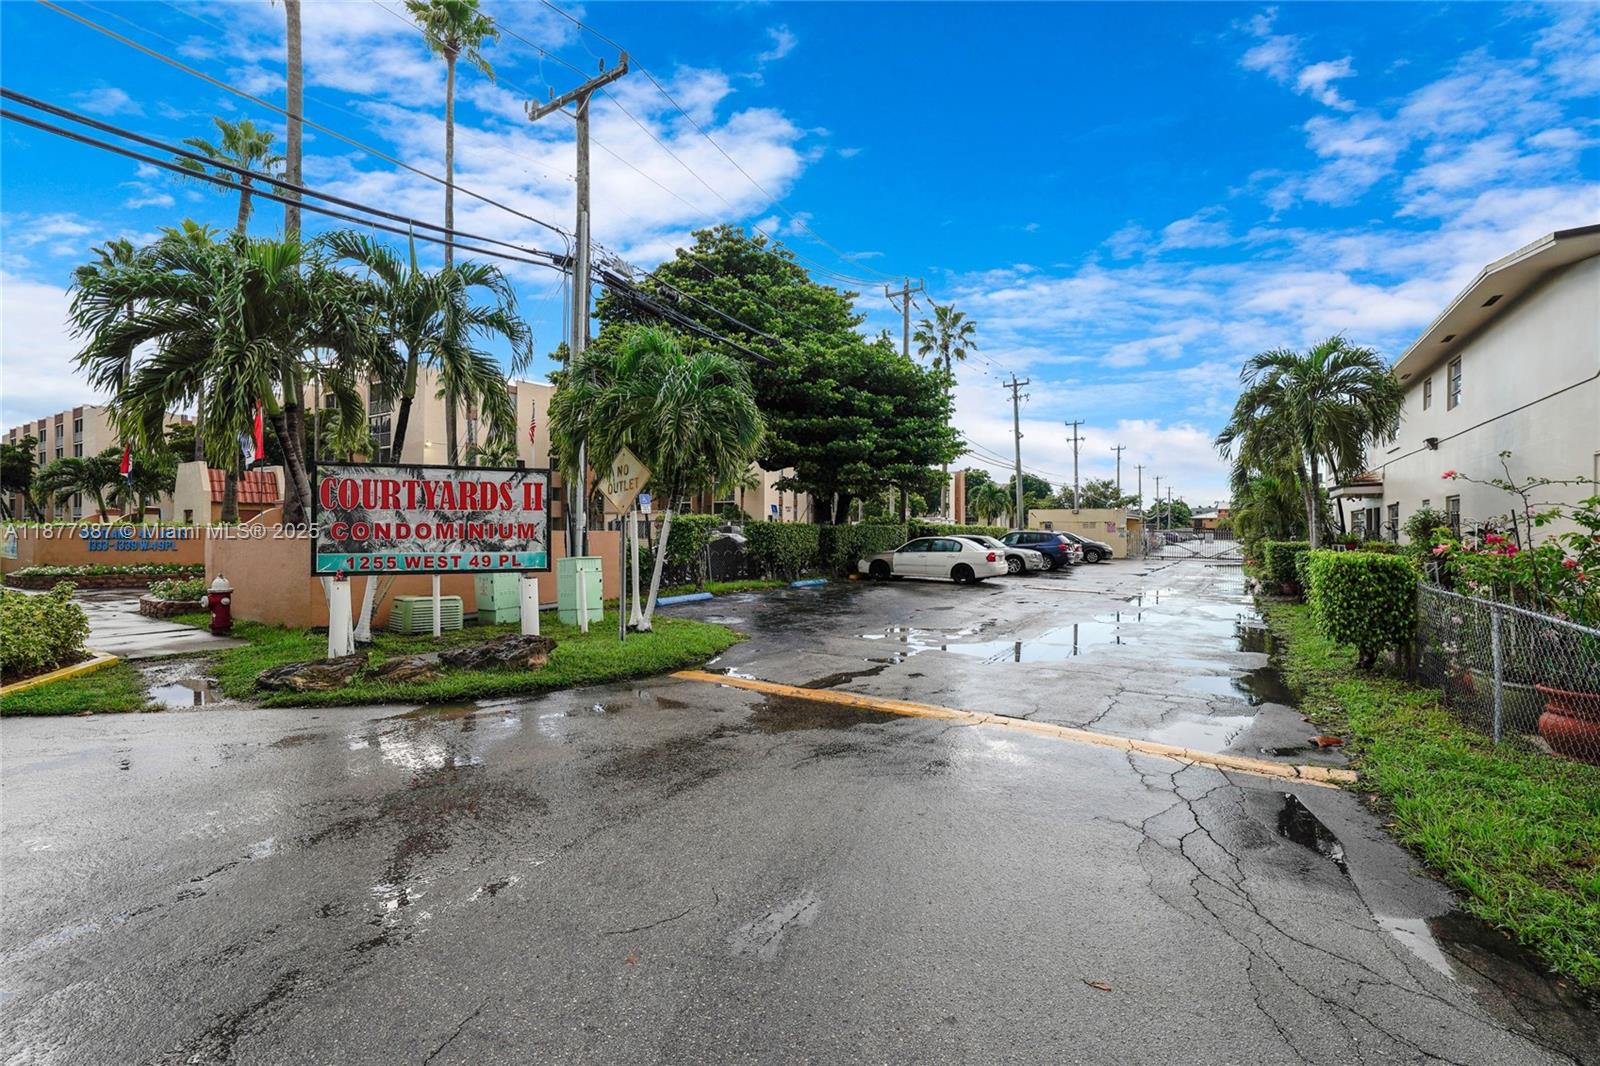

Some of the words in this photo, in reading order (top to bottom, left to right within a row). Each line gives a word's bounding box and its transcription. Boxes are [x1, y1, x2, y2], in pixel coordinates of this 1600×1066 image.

[617, 464, 629, 477] NO
[319, 476, 513, 512] COURTYARDS
[522, 482, 544, 512] II
[607, 477, 640, 495] OUTLET
[331, 522, 536, 540] CONDOMINIUM
[346, 556, 397, 570] 1255
[404, 555, 462, 569] WEST
[469, 555, 492, 568] 49
[499, 554, 522, 567] PL
